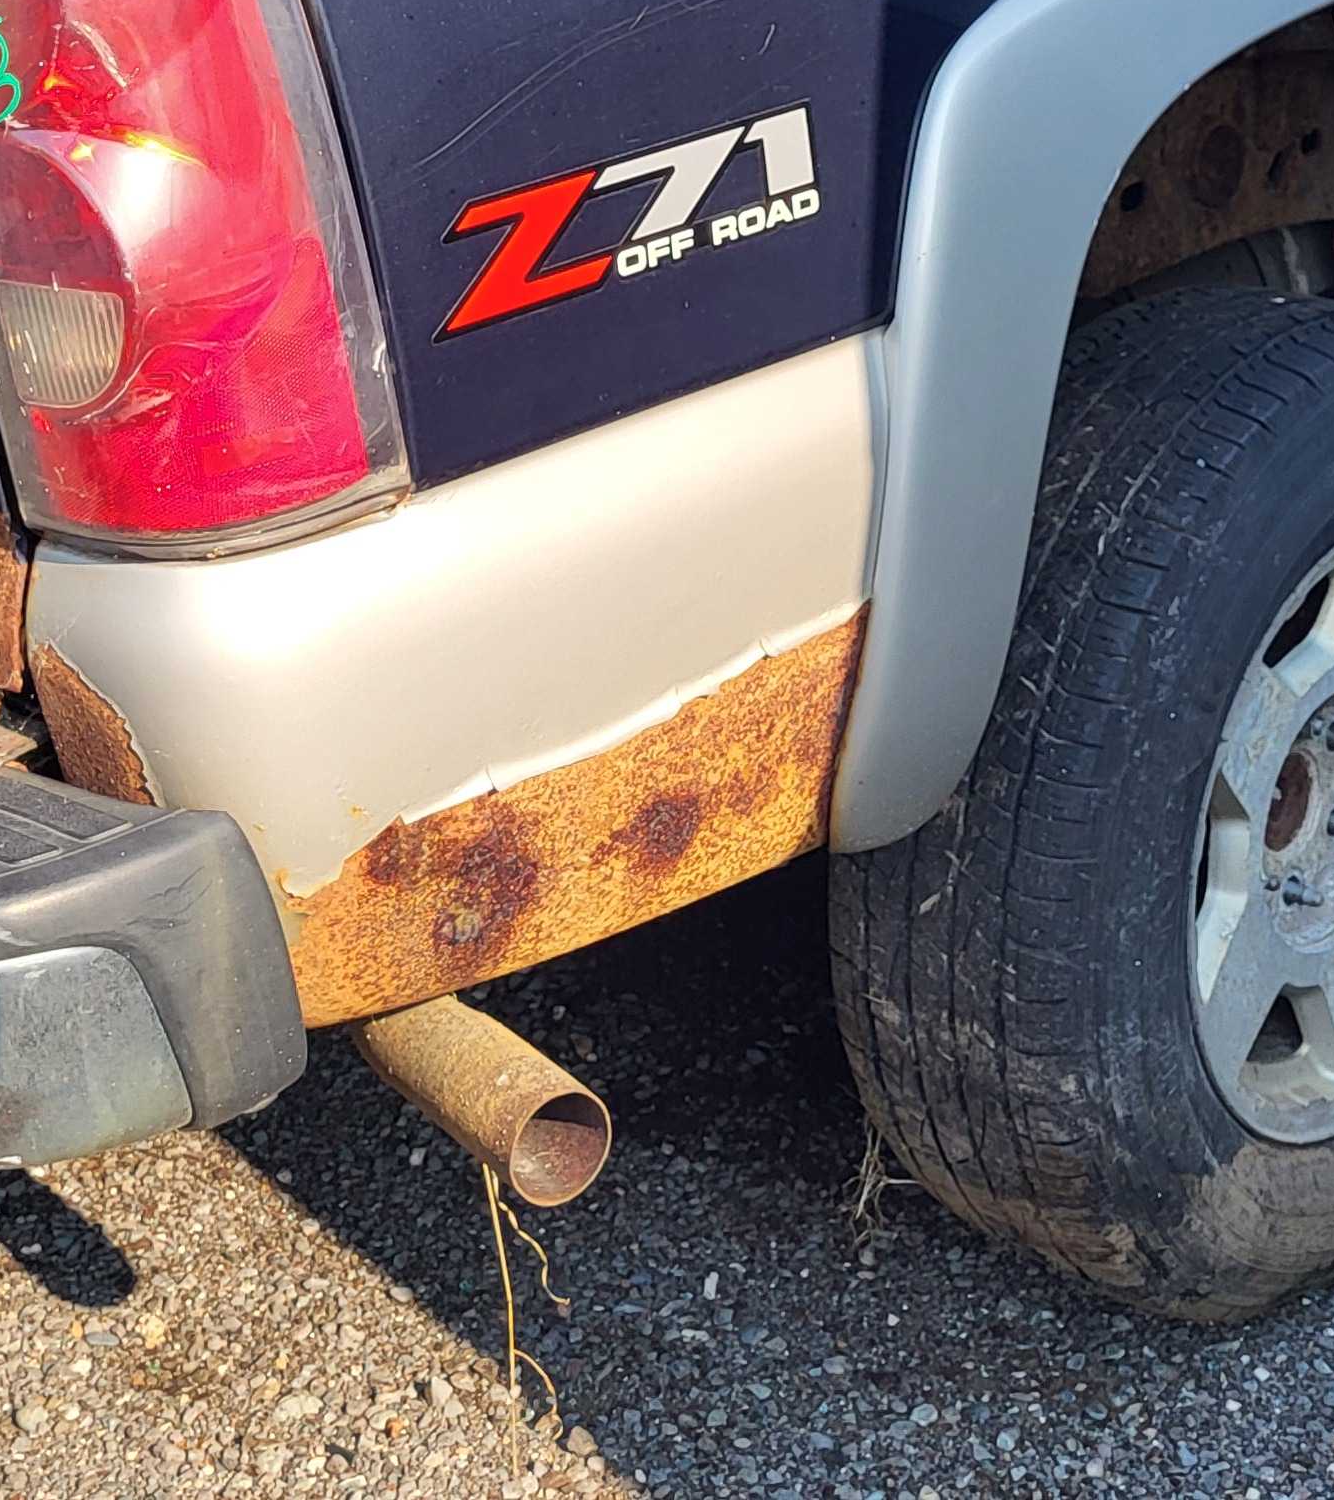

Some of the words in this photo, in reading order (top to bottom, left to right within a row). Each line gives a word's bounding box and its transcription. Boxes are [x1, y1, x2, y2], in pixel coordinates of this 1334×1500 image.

[437, 102, 817, 339] Z71
[616, 227, 696, 278] OFF
[711, 187, 821, 246] ROAD
